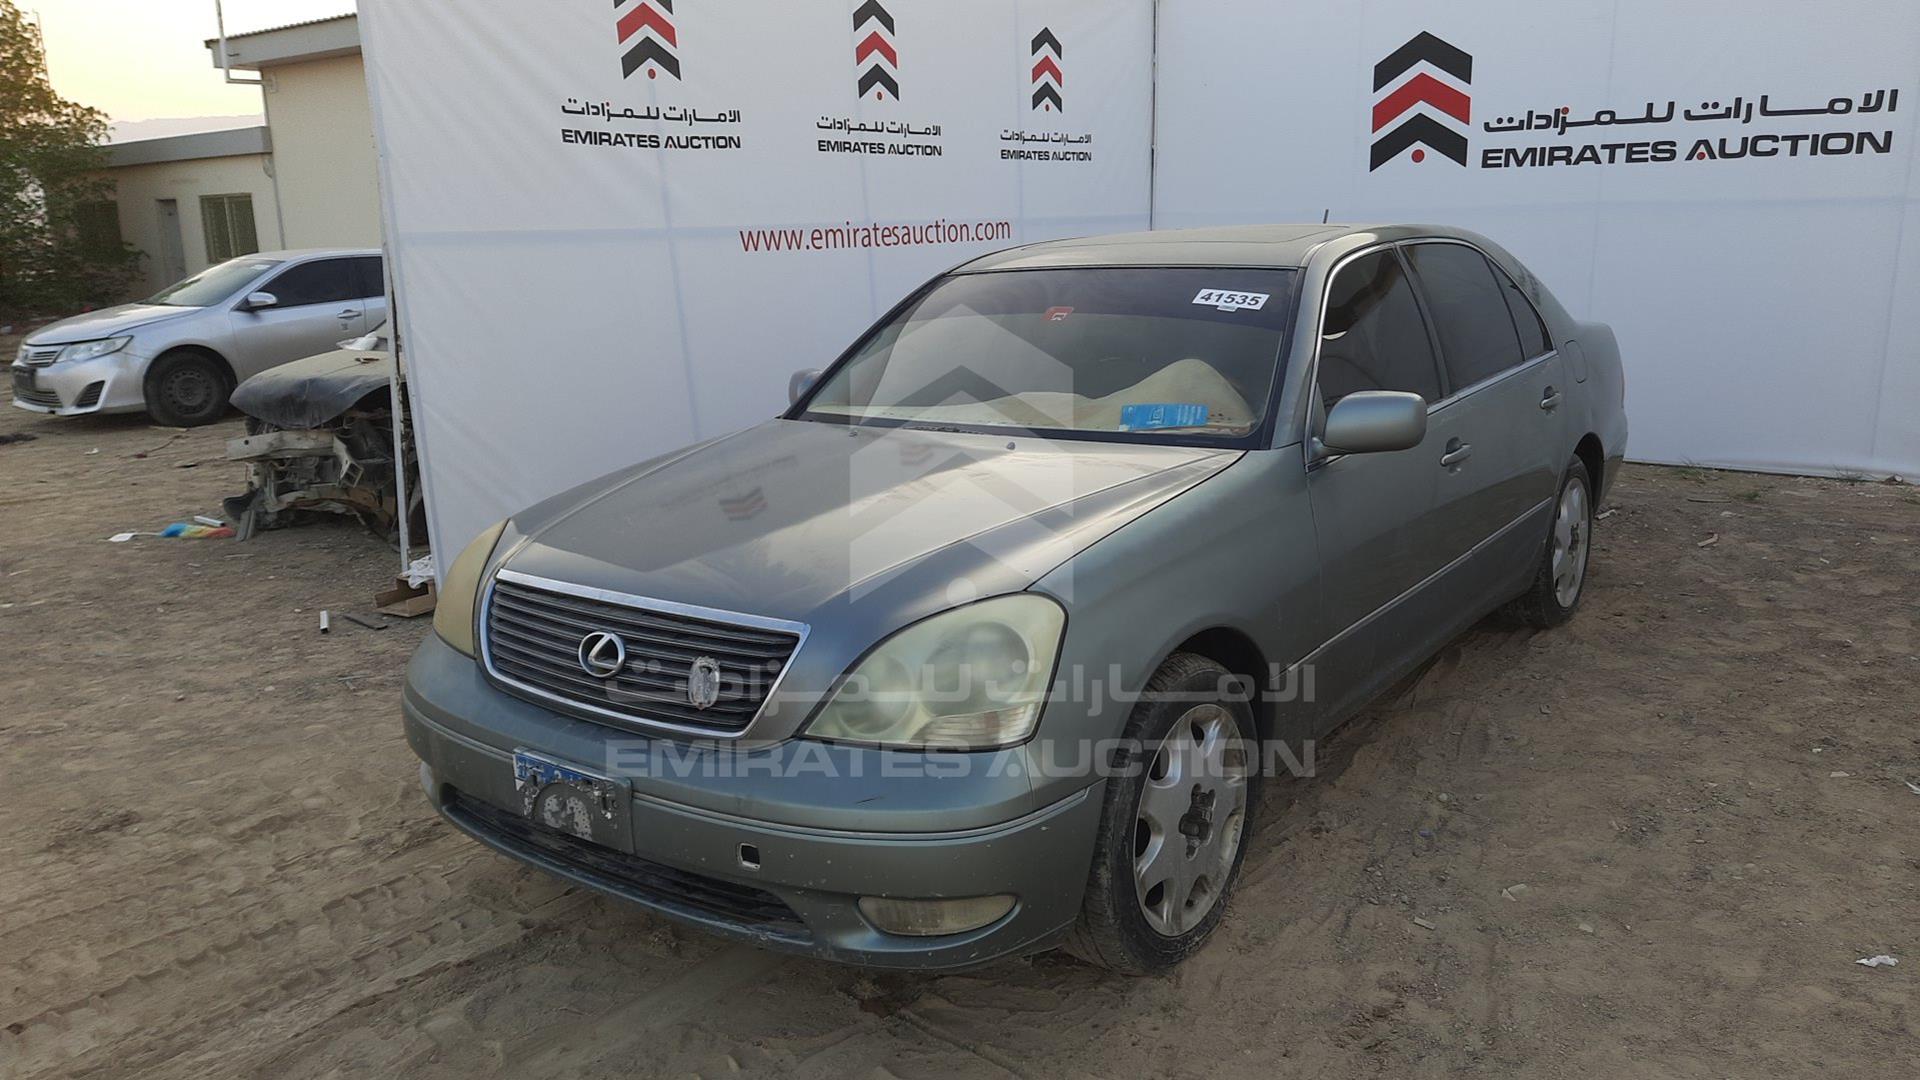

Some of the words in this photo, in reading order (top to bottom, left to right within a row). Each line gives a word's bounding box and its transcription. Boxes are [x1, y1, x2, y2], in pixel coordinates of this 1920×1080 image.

[561, 128, 660, 149] EMIRATES
[664, 135, 741, 149] AUCTION
[817, 139, 885, 155] EMIRATES
[888, 144, 942, 157] AUCTION
[1000, 149, 1050, 161] EMIRATES
[1051, 151, 1092, 162] AUCTION
[1481, 140, 1677, 169] EMIRATES
[1685, 130, 1893, 161] AUCTION
[740, 218, 1011, 252] www.emiratesauction.com
[1200, 292, 1262, 306] 41535
